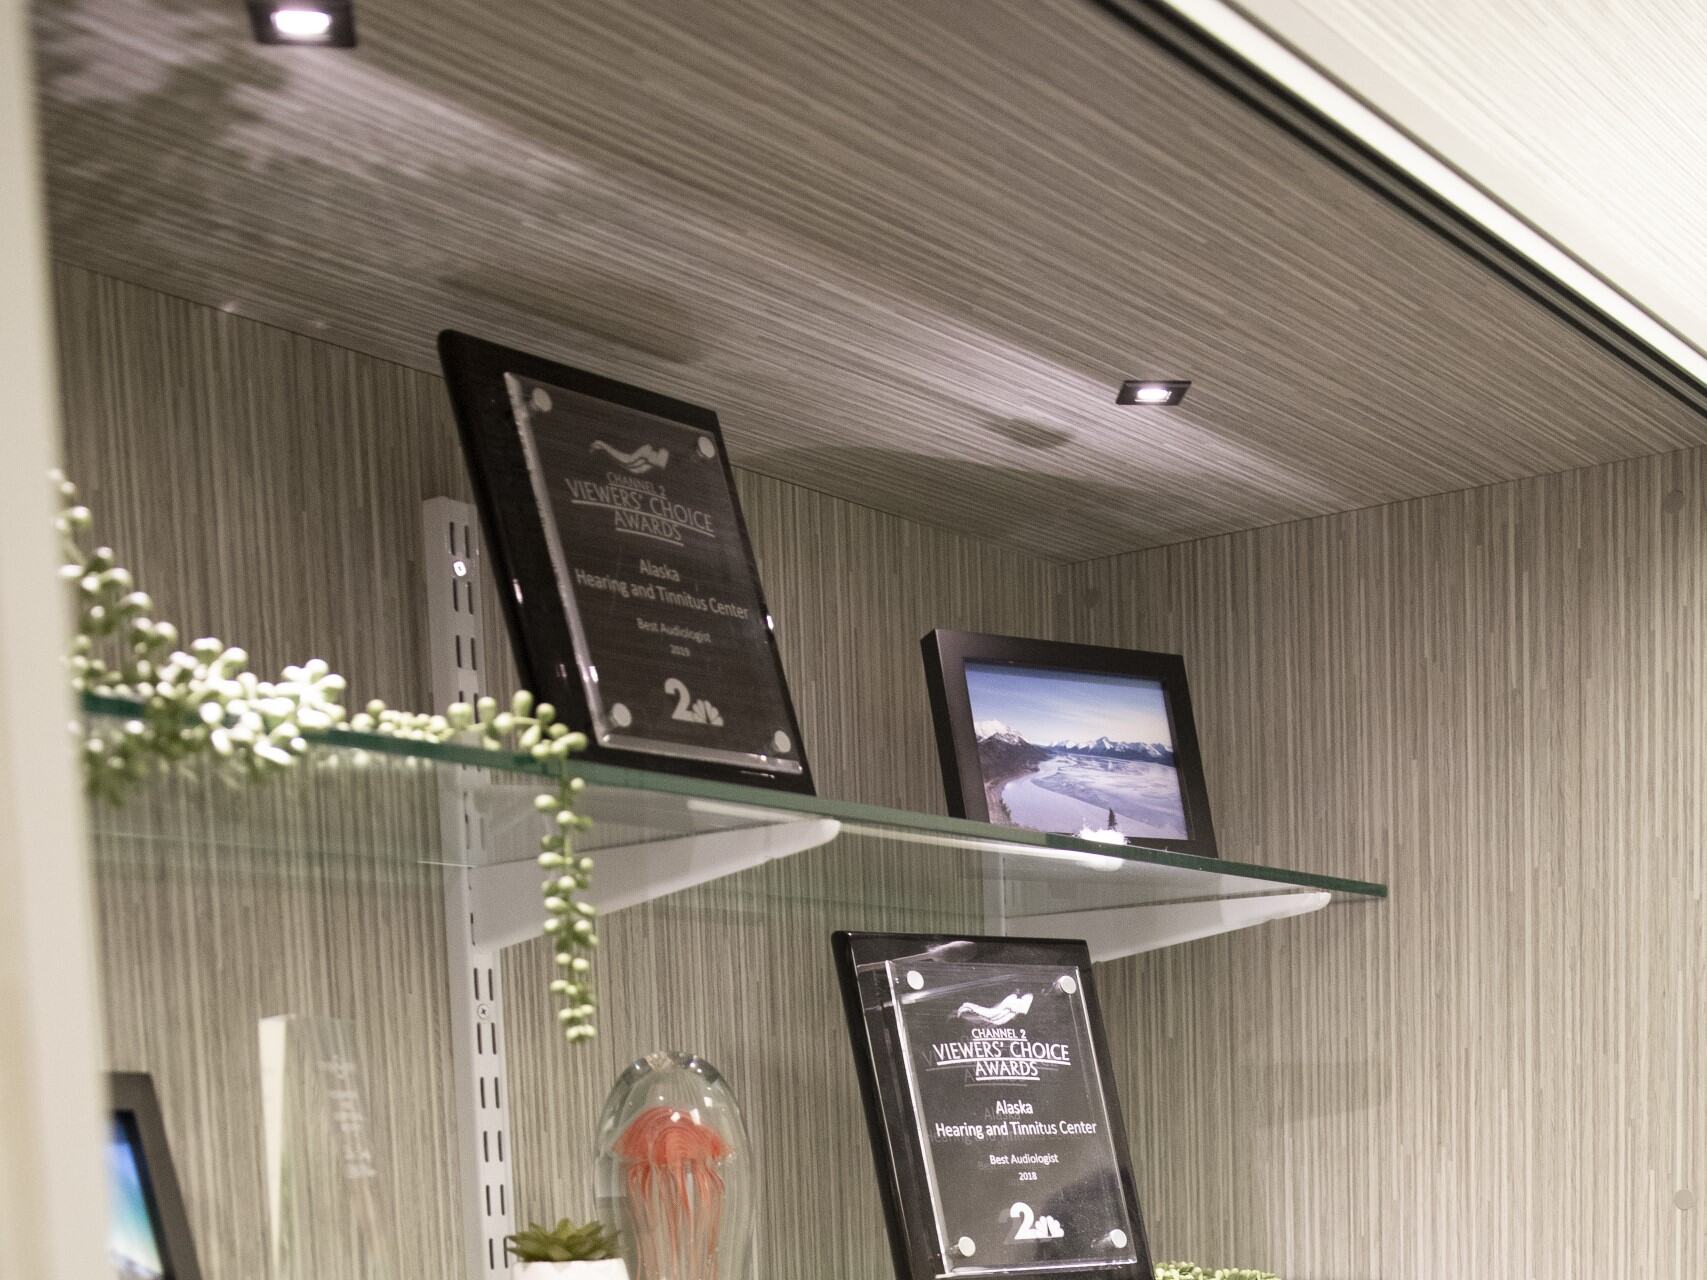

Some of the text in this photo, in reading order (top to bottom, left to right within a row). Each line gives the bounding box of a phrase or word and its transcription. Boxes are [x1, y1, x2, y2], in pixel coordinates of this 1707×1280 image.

[606, 472, 666, 495] CHANNEL 2
[565, 478, 714, 532] VIEWERS' CHOICE
[614, 511, 682, 541] AWARDS
[639, 558, 681, 582] Alaska
[574, 568, 749, 619] Hearing and Tinnitus Center
[971, 1028, 1027, 1039] CHANNEL 2
[932, 1040, 1071, 1061] VIEWERS' CHOICE
[975, 1061, 1039, 1077] AWARDS
[995, 1100, 1034, 1115] Alaska
[935, 1120, 1097, 1140] Hearing and Tinnitus Center
[989, 1153, 1059, 1166] Best Audiologist
[1018, 1171, 1038, 1182] 2018
